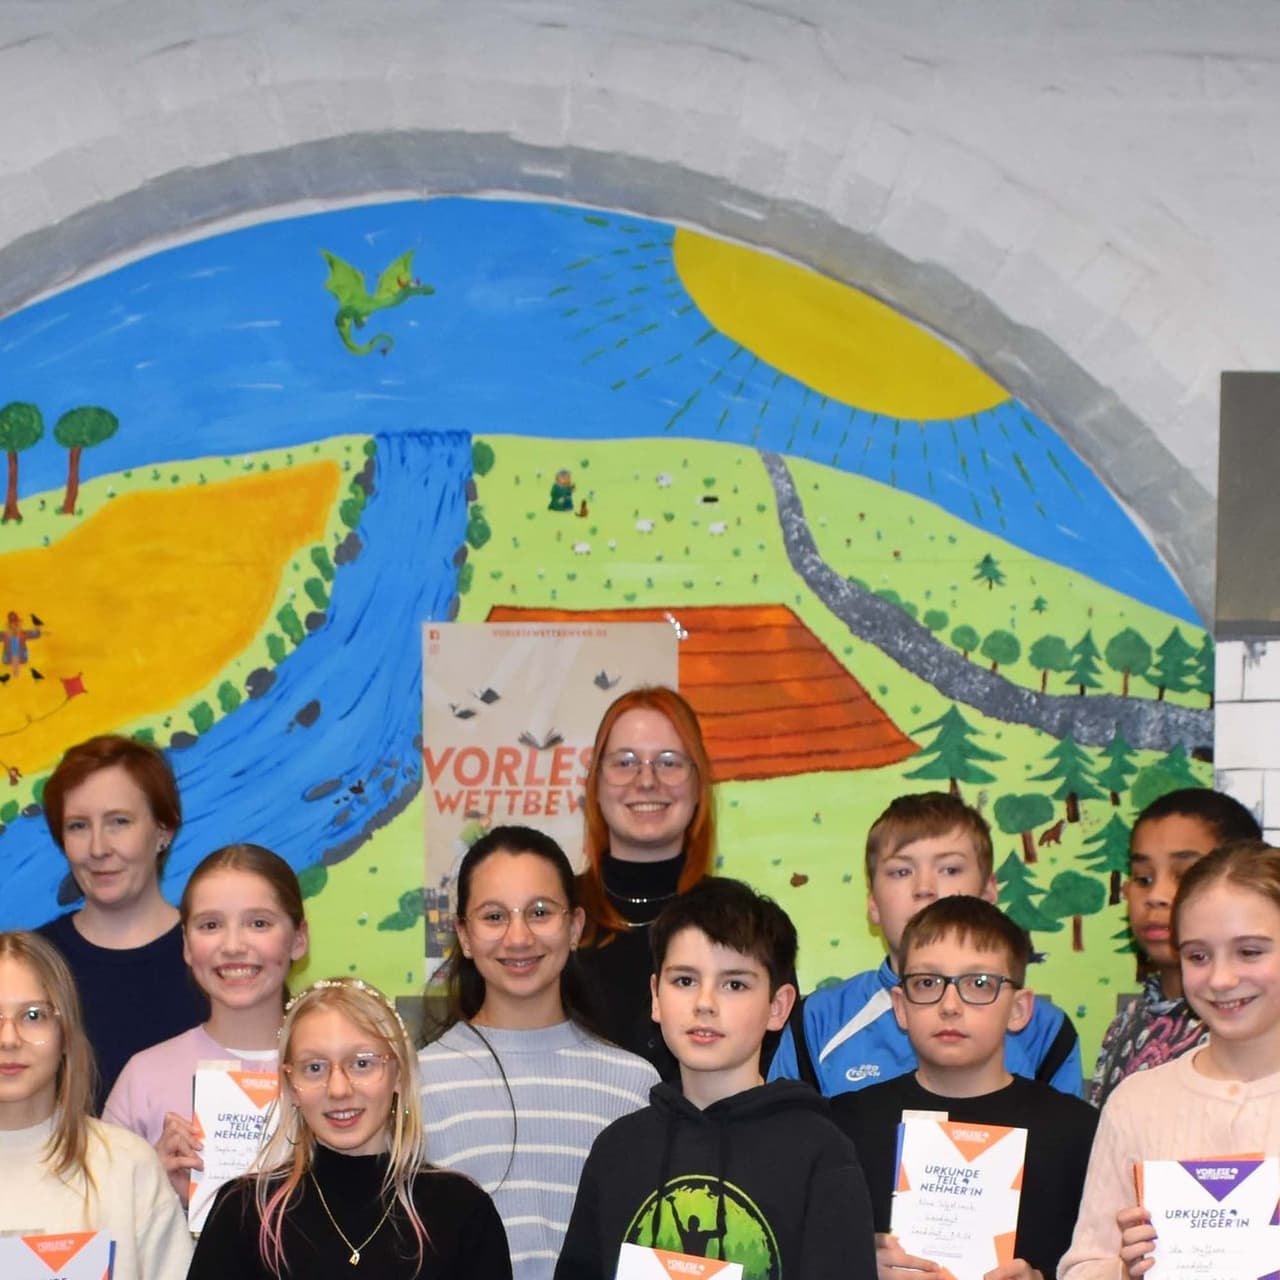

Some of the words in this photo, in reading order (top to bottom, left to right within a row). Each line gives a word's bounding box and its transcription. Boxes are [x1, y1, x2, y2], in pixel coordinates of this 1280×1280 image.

[423, 746, 594, 787] VORLES
[433, 788, 581, 816] WETTBE
[230, 1122, 250, 1132] TEIL
[924, 1164, 980, 1178] URKUNDE
[937, 1175, 958, 1186] TEIL
[1165, 1208, 1226, 1219] URKUNDE
